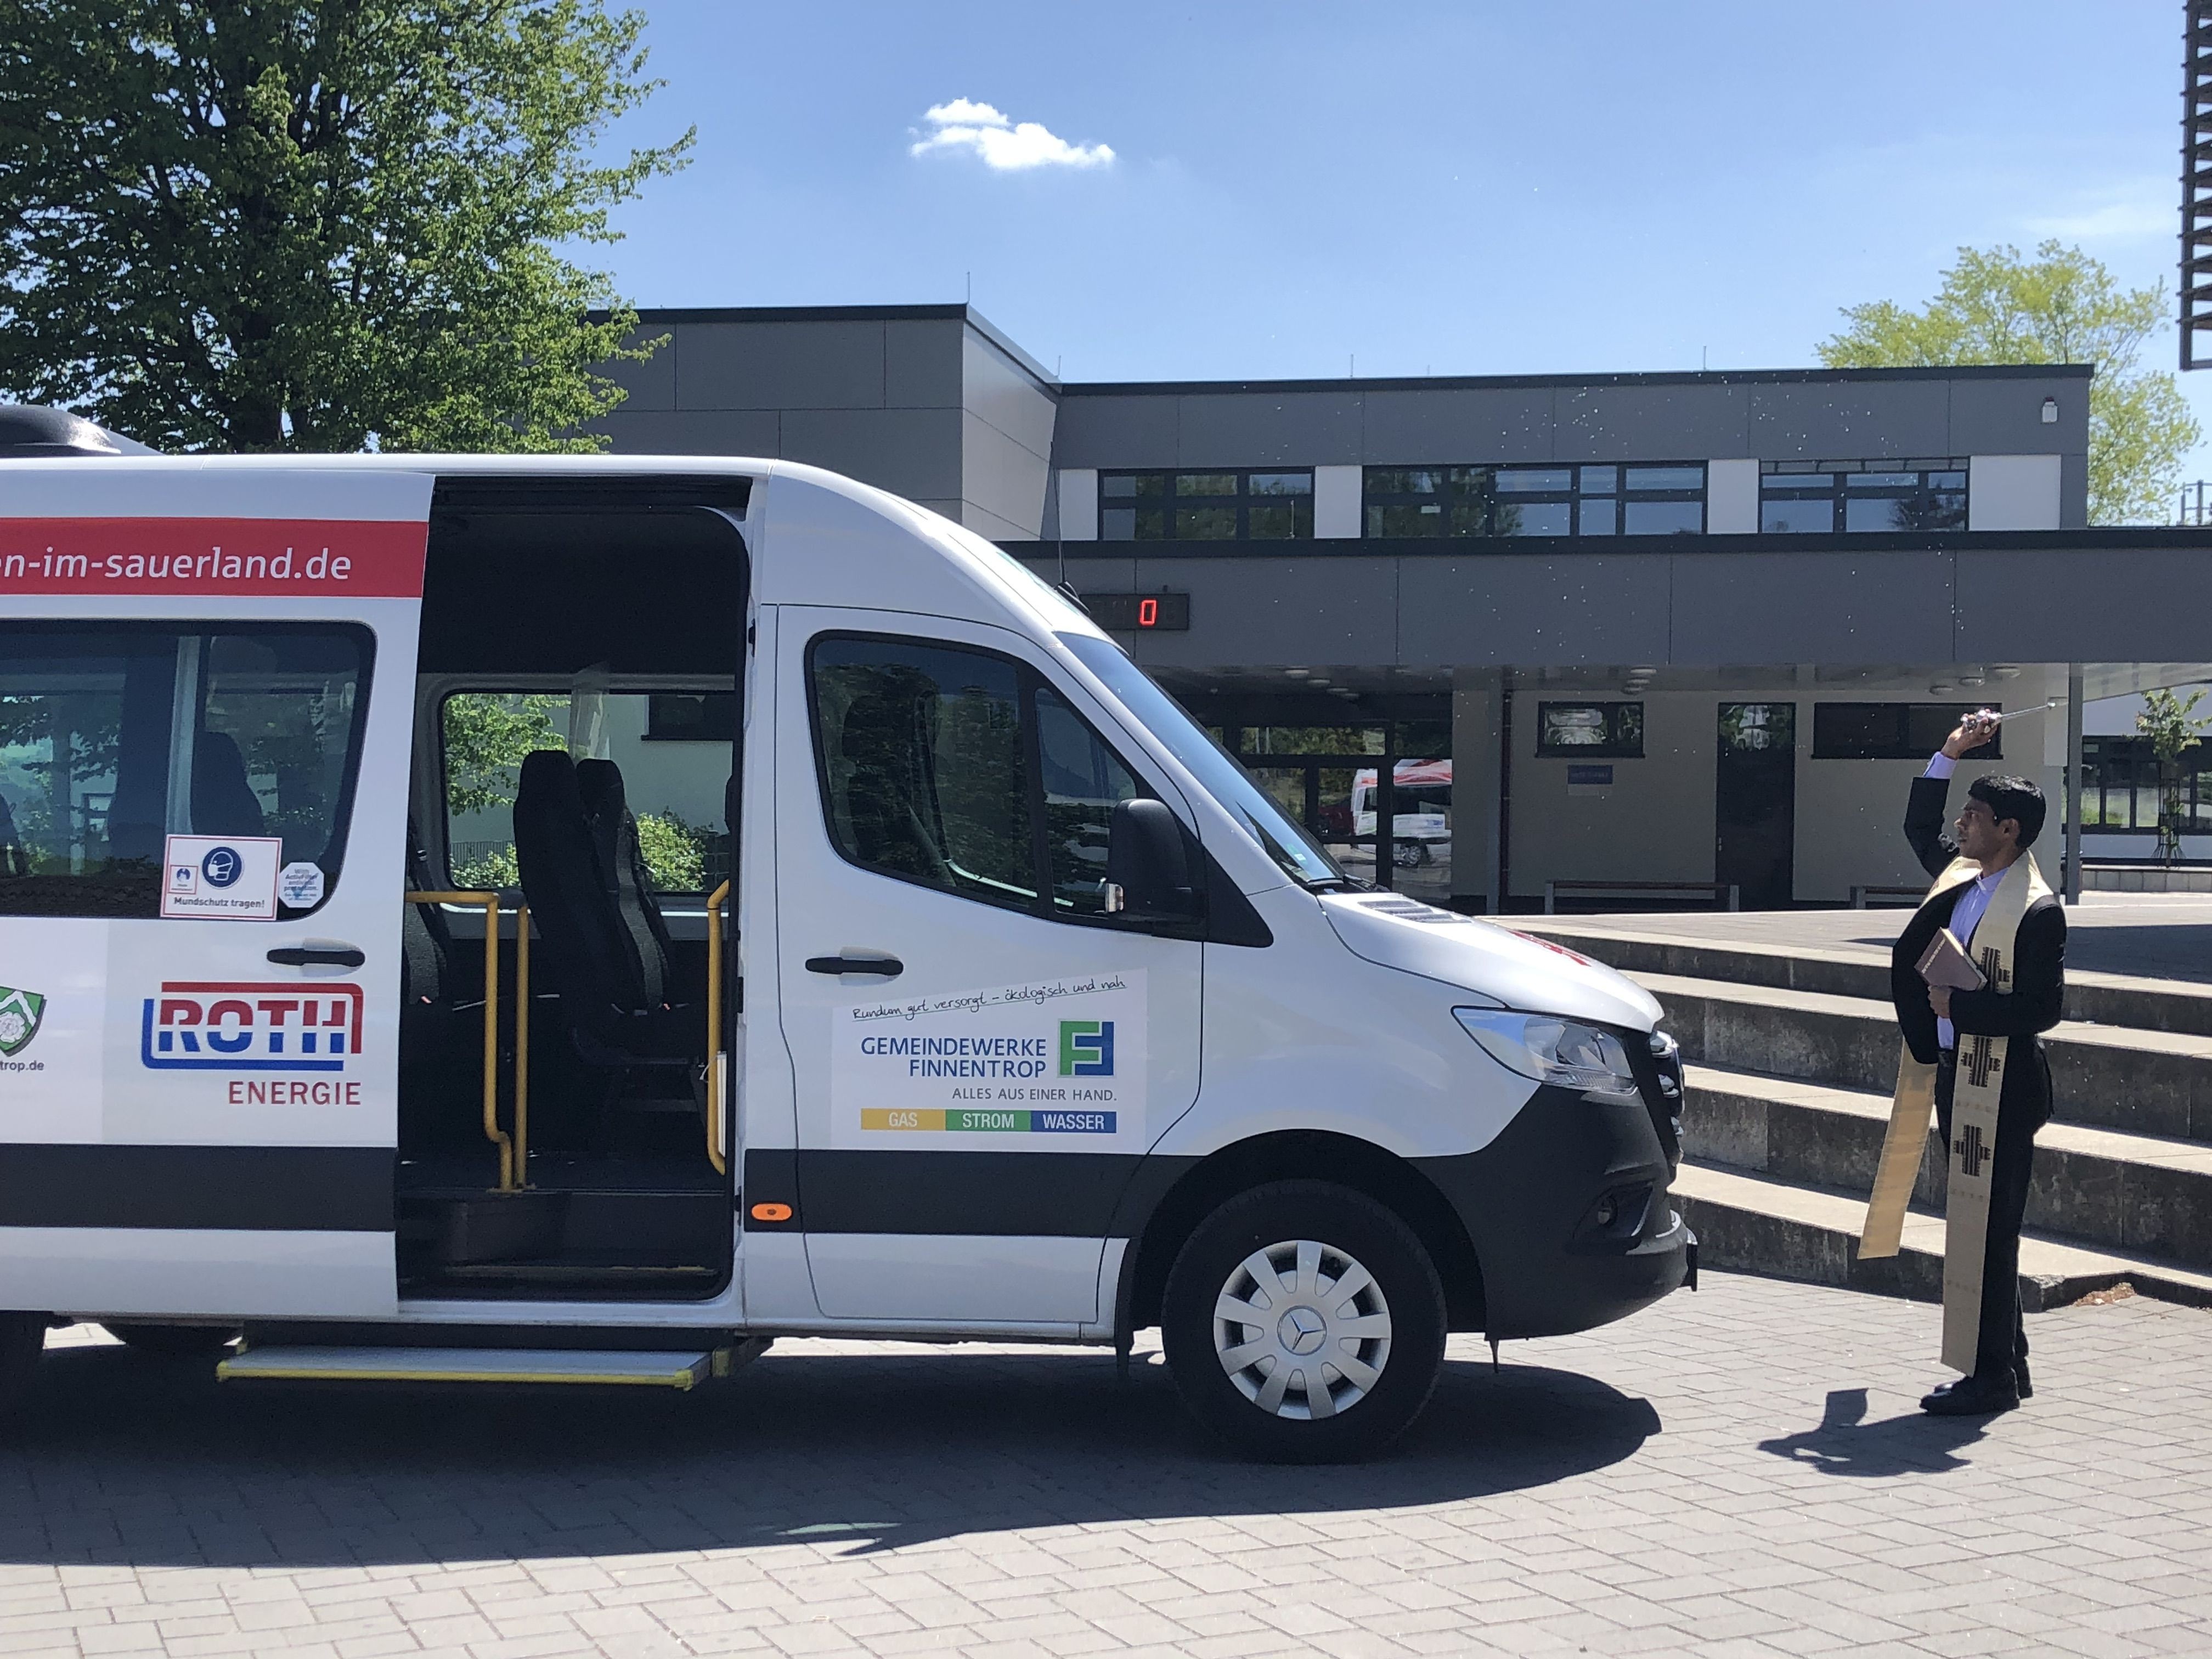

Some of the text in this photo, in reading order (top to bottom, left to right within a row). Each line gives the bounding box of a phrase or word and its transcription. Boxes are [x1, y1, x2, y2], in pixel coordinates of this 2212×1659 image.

[0, 546, 351, 579] n-im-sauerland.de
[1139, 600, 1157, 625] 0
[173, 896, 265, 910] Mundschutz tragen!
[853, 1004, 902, 1019] Rundum
[905, 998, 929, 1021] gut
[934, 991, 986, 1013] versorgt
[1005, 981, 1068, 1005] ökologisch
[1073, 978, 1095, 992] und
[1101, 975, 1125, 989] nah
[158, 999, 347, 1054] ROTH
[861, 1037, 1046, 1057] GEMEINDEWERKE
[910, 1059, 1046, 1078] FINNENTROP
[229, 1081, 361, 1105] ENERGIE
[952, 1088, 1117, 1102] ALLES AUS EINER HAND.
[888, 1111, 1104, 1130] GAS STROM WASSER
